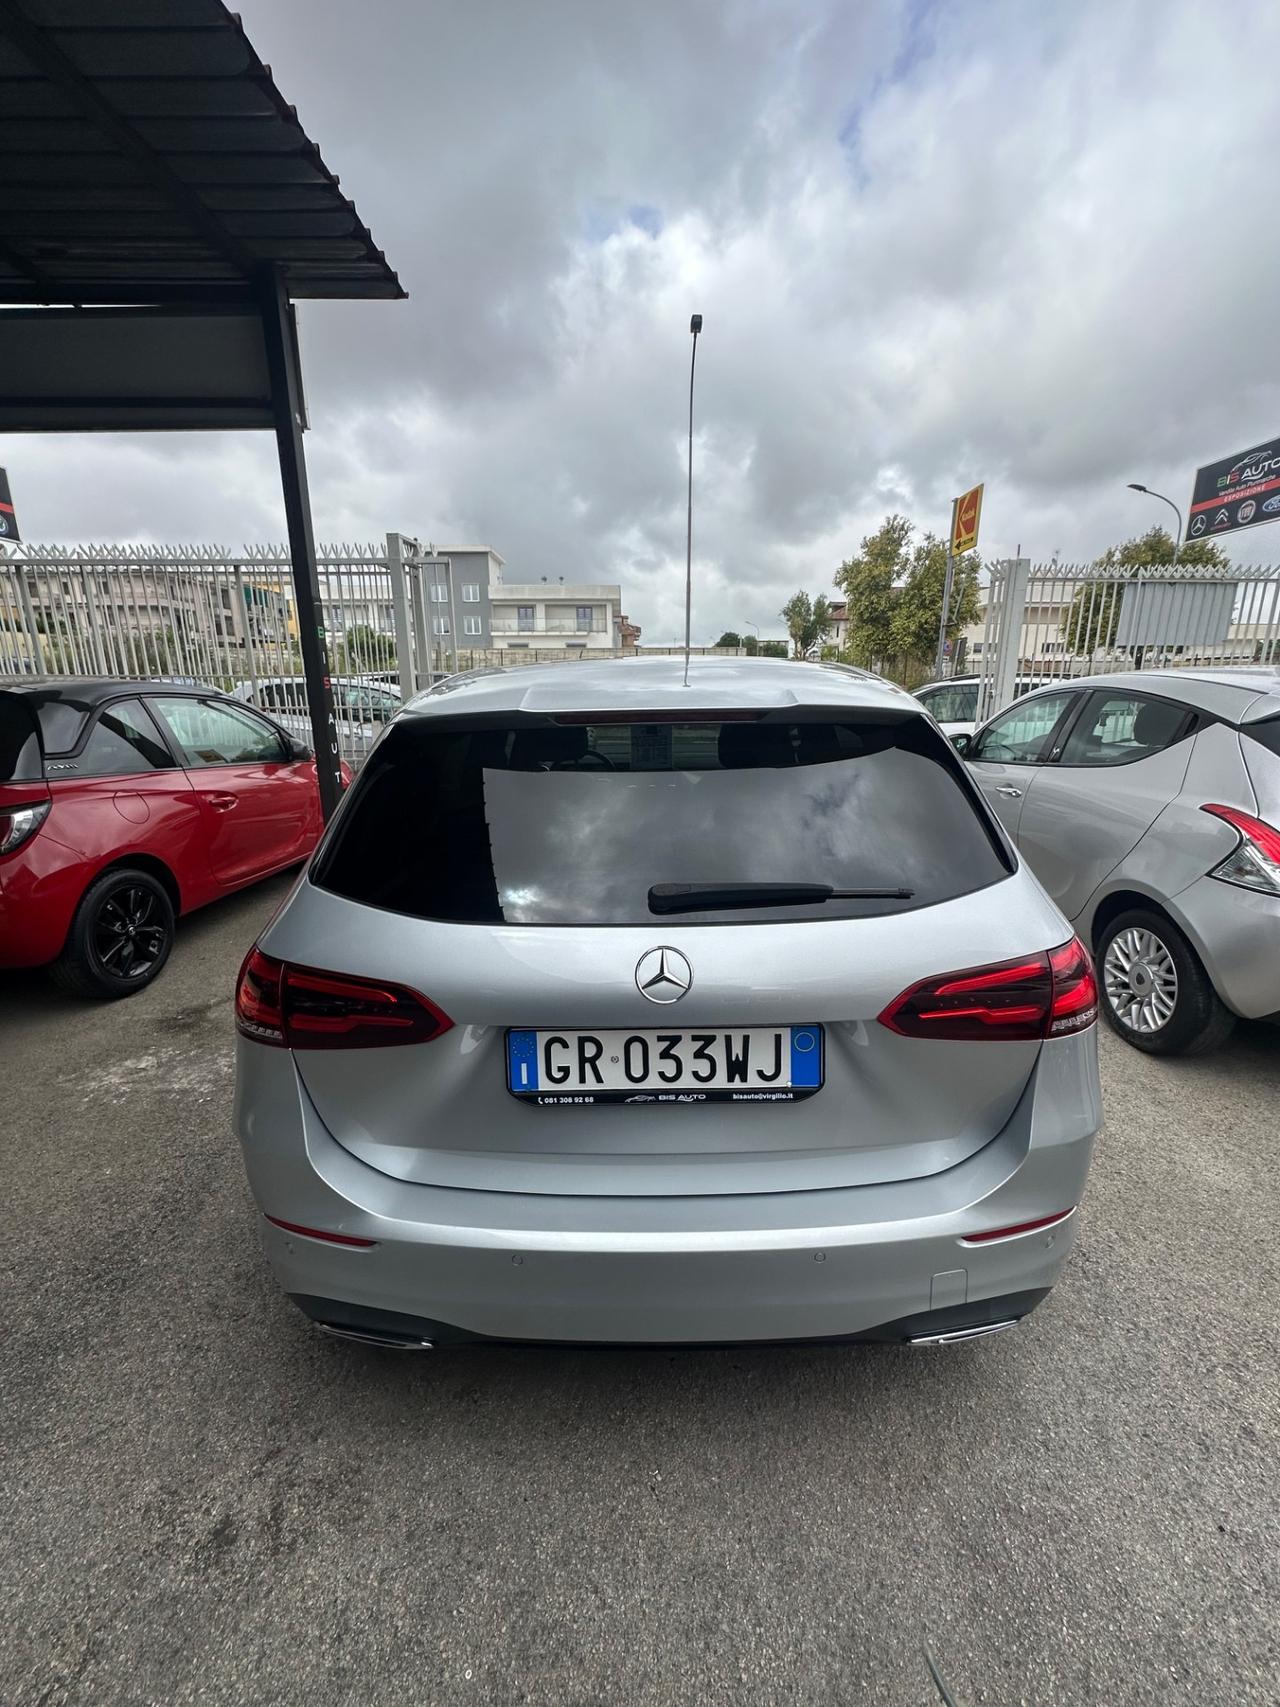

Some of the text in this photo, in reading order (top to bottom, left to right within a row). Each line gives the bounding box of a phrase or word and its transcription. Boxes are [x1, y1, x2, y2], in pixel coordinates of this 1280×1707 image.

[1217, 457, 1280, 488] BIS AUTO
[1223, 484, 1265, 503] ESPOSIZIONE
[328, 713, 341, 783] AUT
[544, 1034, 782, 1084] GR 033WJ
[574, 1096, 583, 1104] 92
[676, 1093, 706, 1102] AUTO
